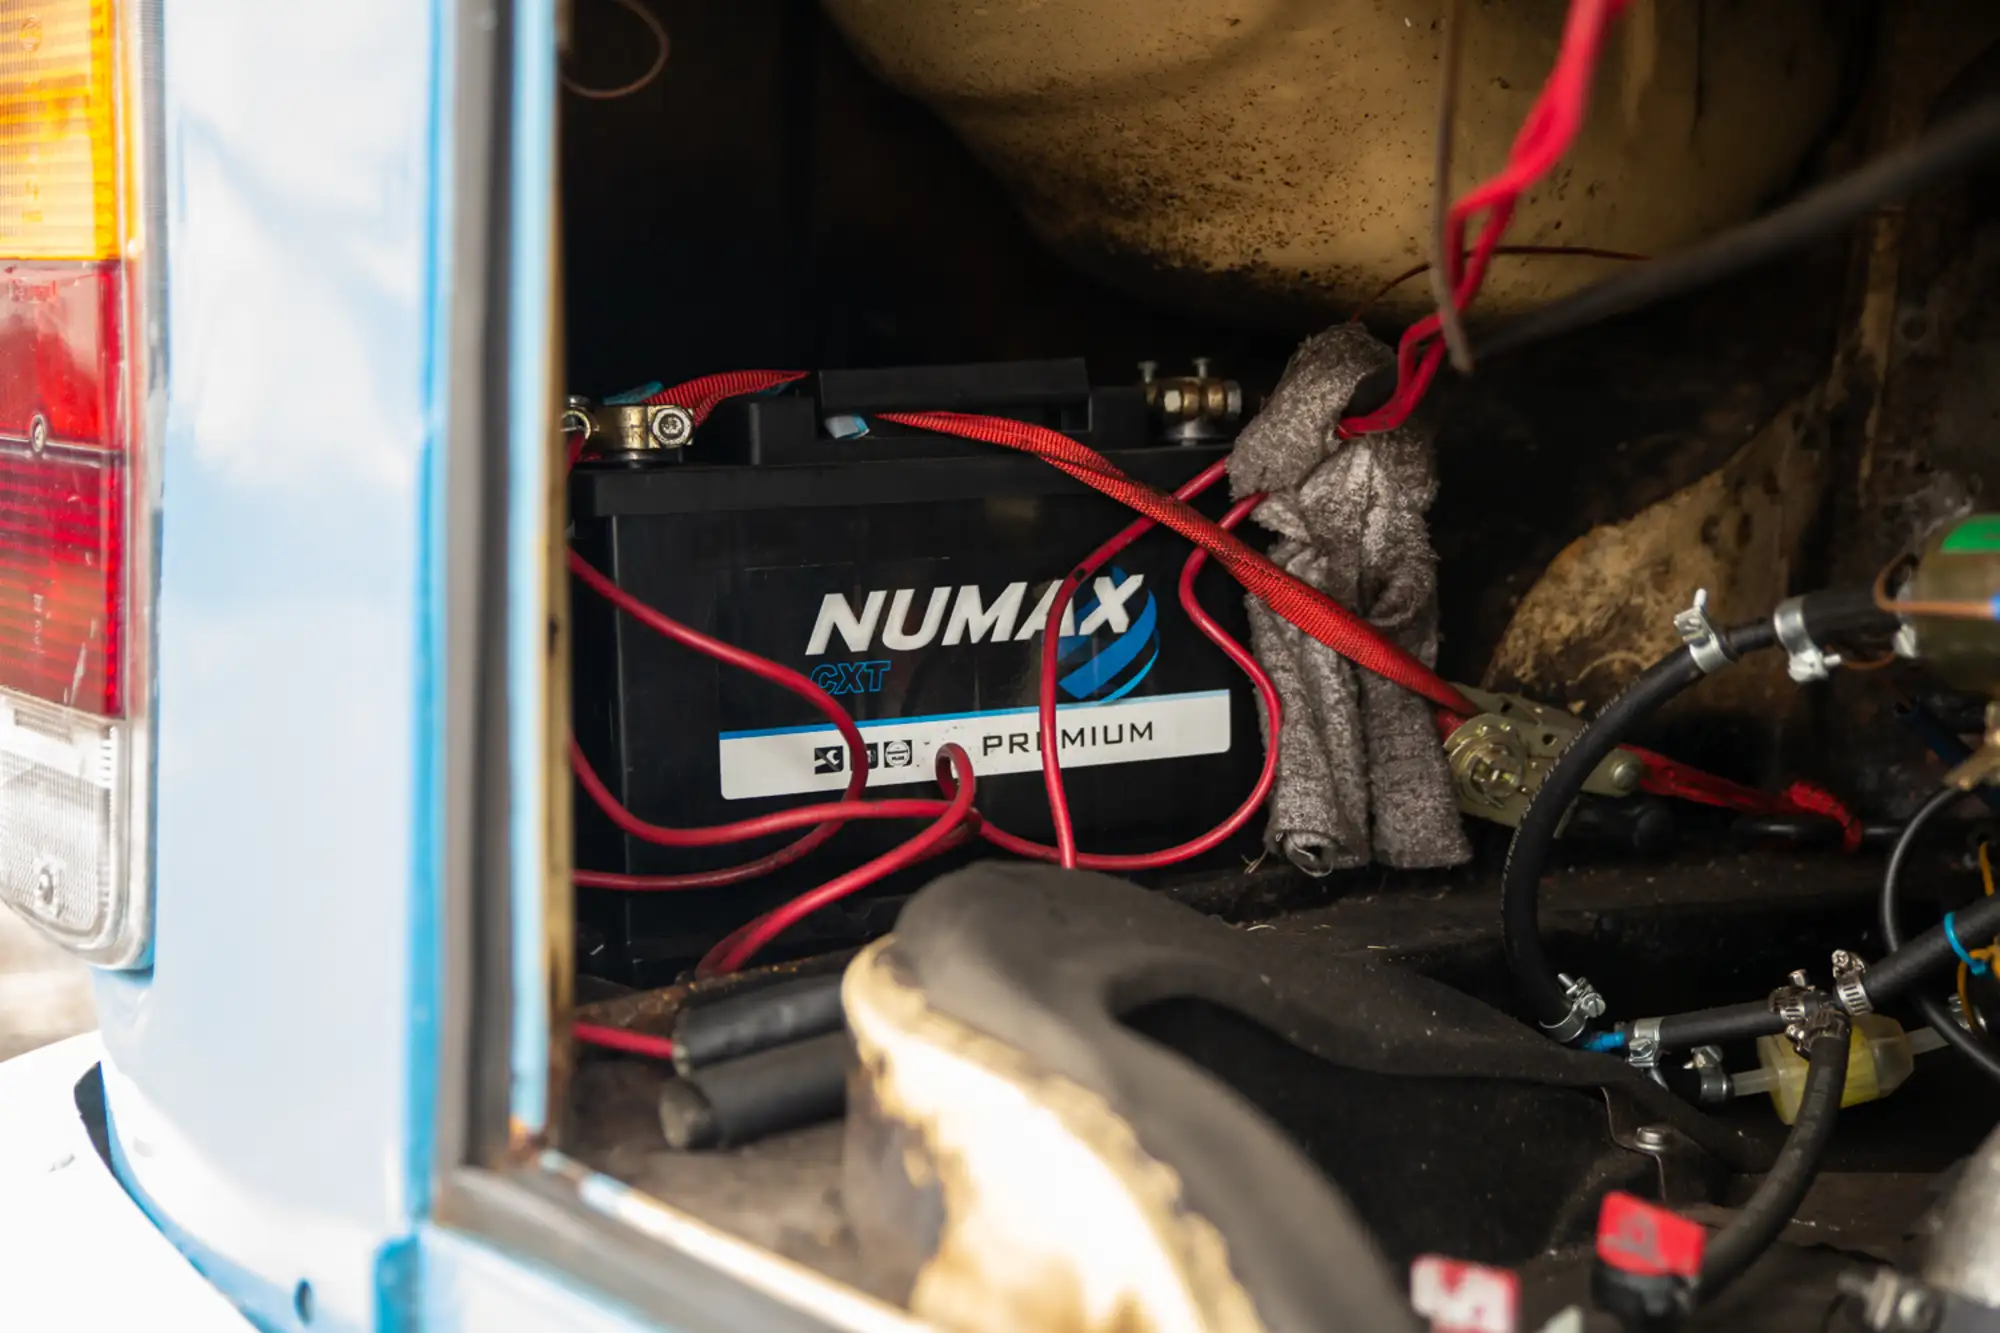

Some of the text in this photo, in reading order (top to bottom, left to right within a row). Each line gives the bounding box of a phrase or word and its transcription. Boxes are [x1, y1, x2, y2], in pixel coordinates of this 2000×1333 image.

[805, 574, 1144, 655] NUMAX
[810, 660, 891, 695] CXT
[983, 721, 1153, 756] PRMIUM
